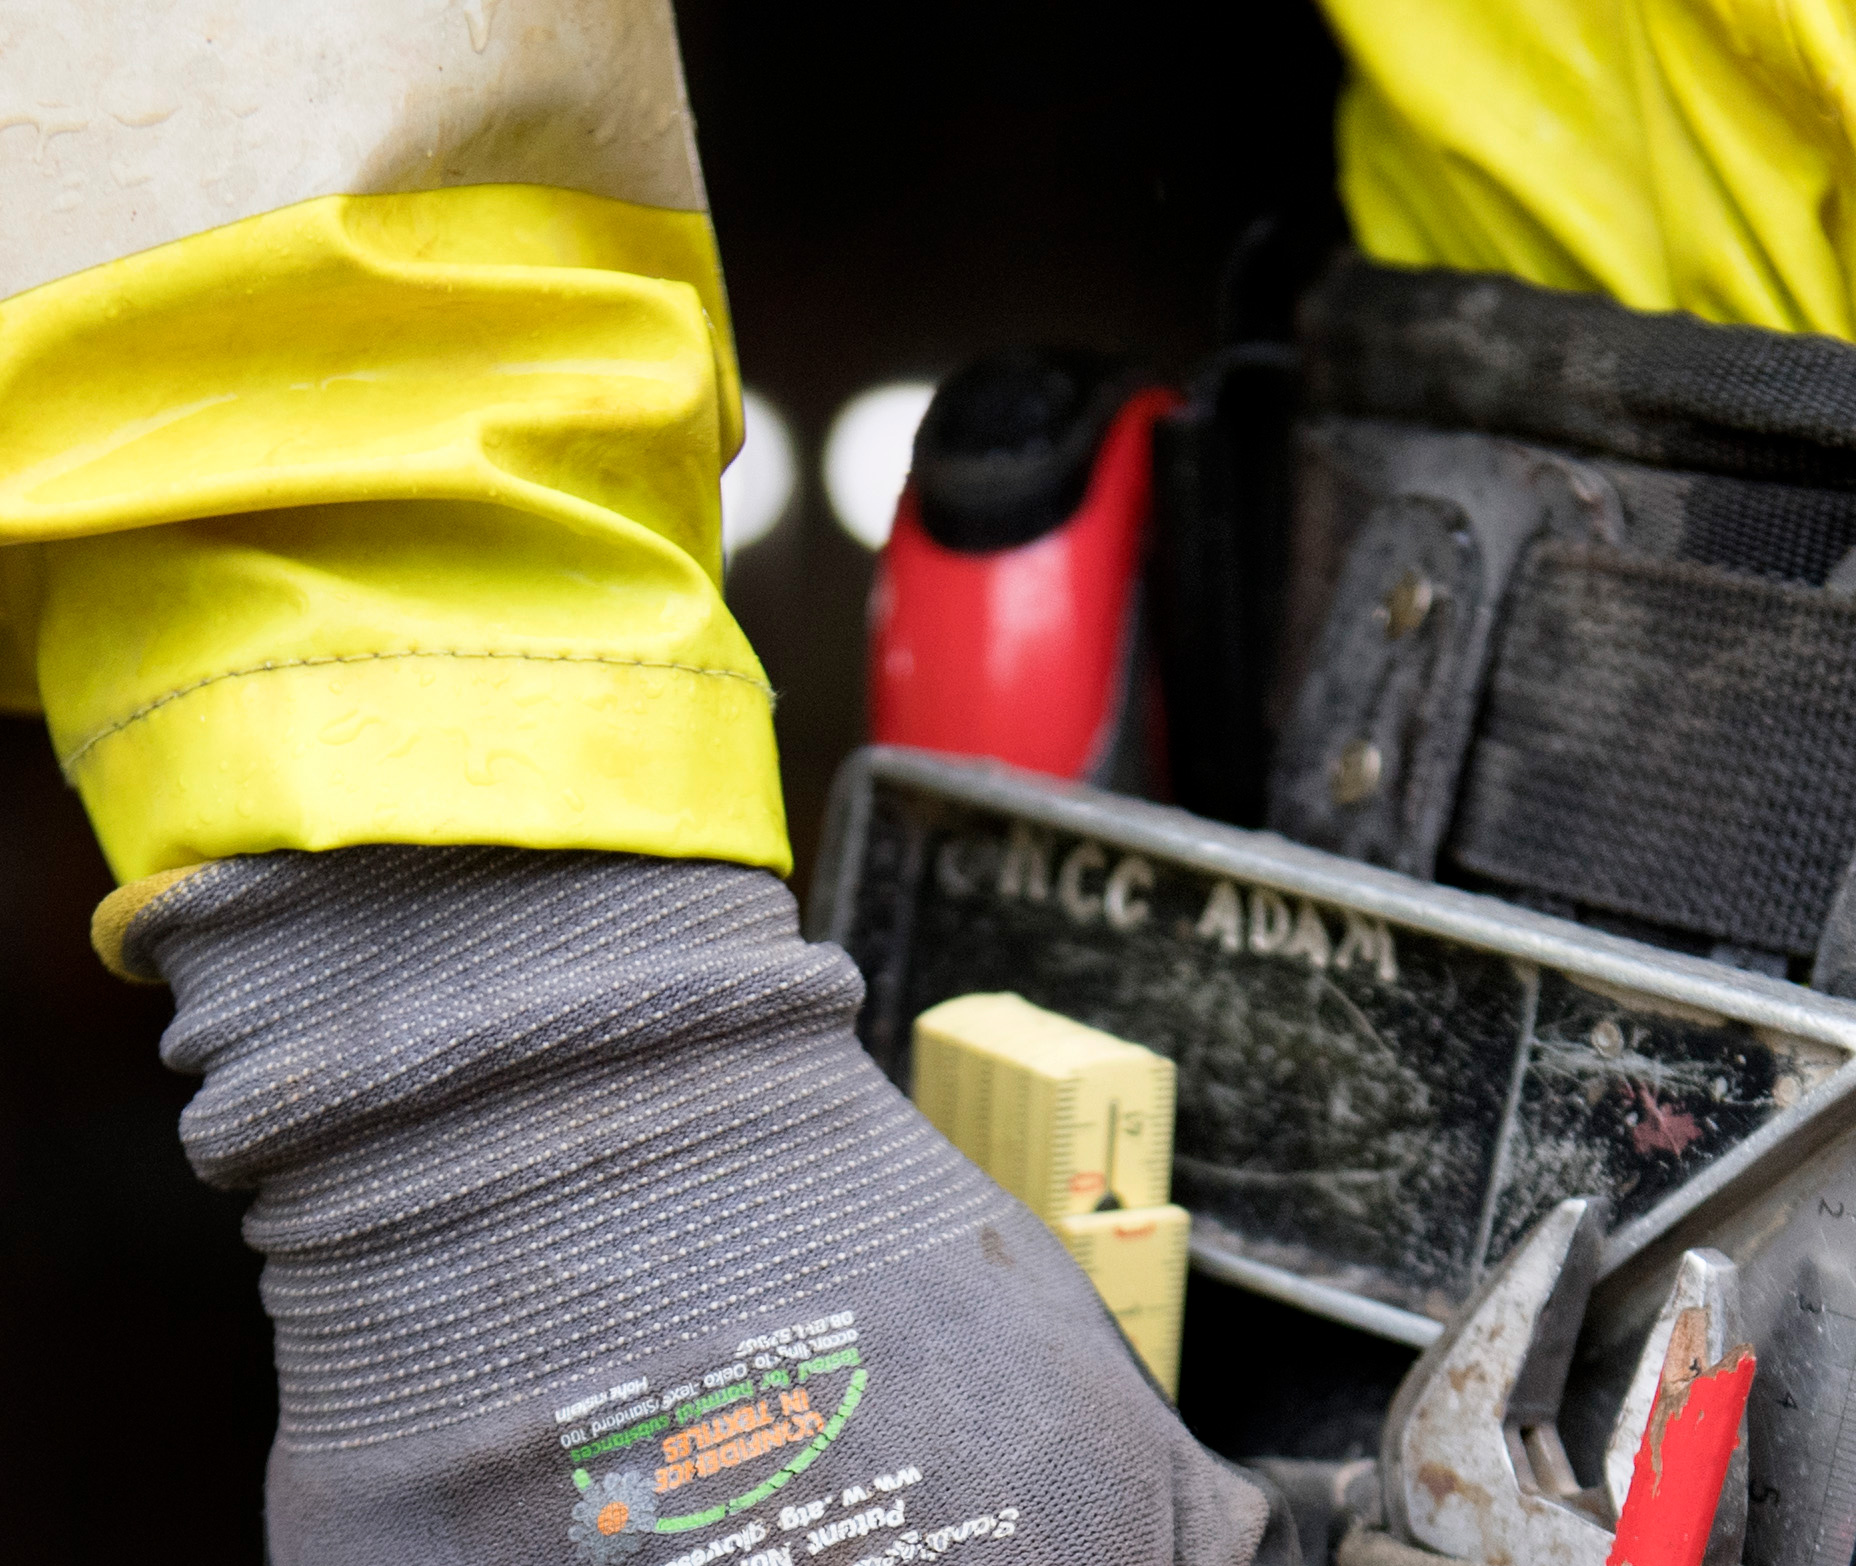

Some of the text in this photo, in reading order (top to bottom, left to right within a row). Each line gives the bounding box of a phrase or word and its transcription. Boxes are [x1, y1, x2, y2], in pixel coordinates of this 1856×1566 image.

[1197, 877, 1398, 981] ADAM
[1818, 1198, 1844, 1218] 2
[559, 1426, 588, 1449] 100
[570, 1348, 863, 1462] Tested for harmful substances
[661, 1388, 811, 1463] IN TEXTILES
[654, 1410, 826, 1493] CONFIDENCE
